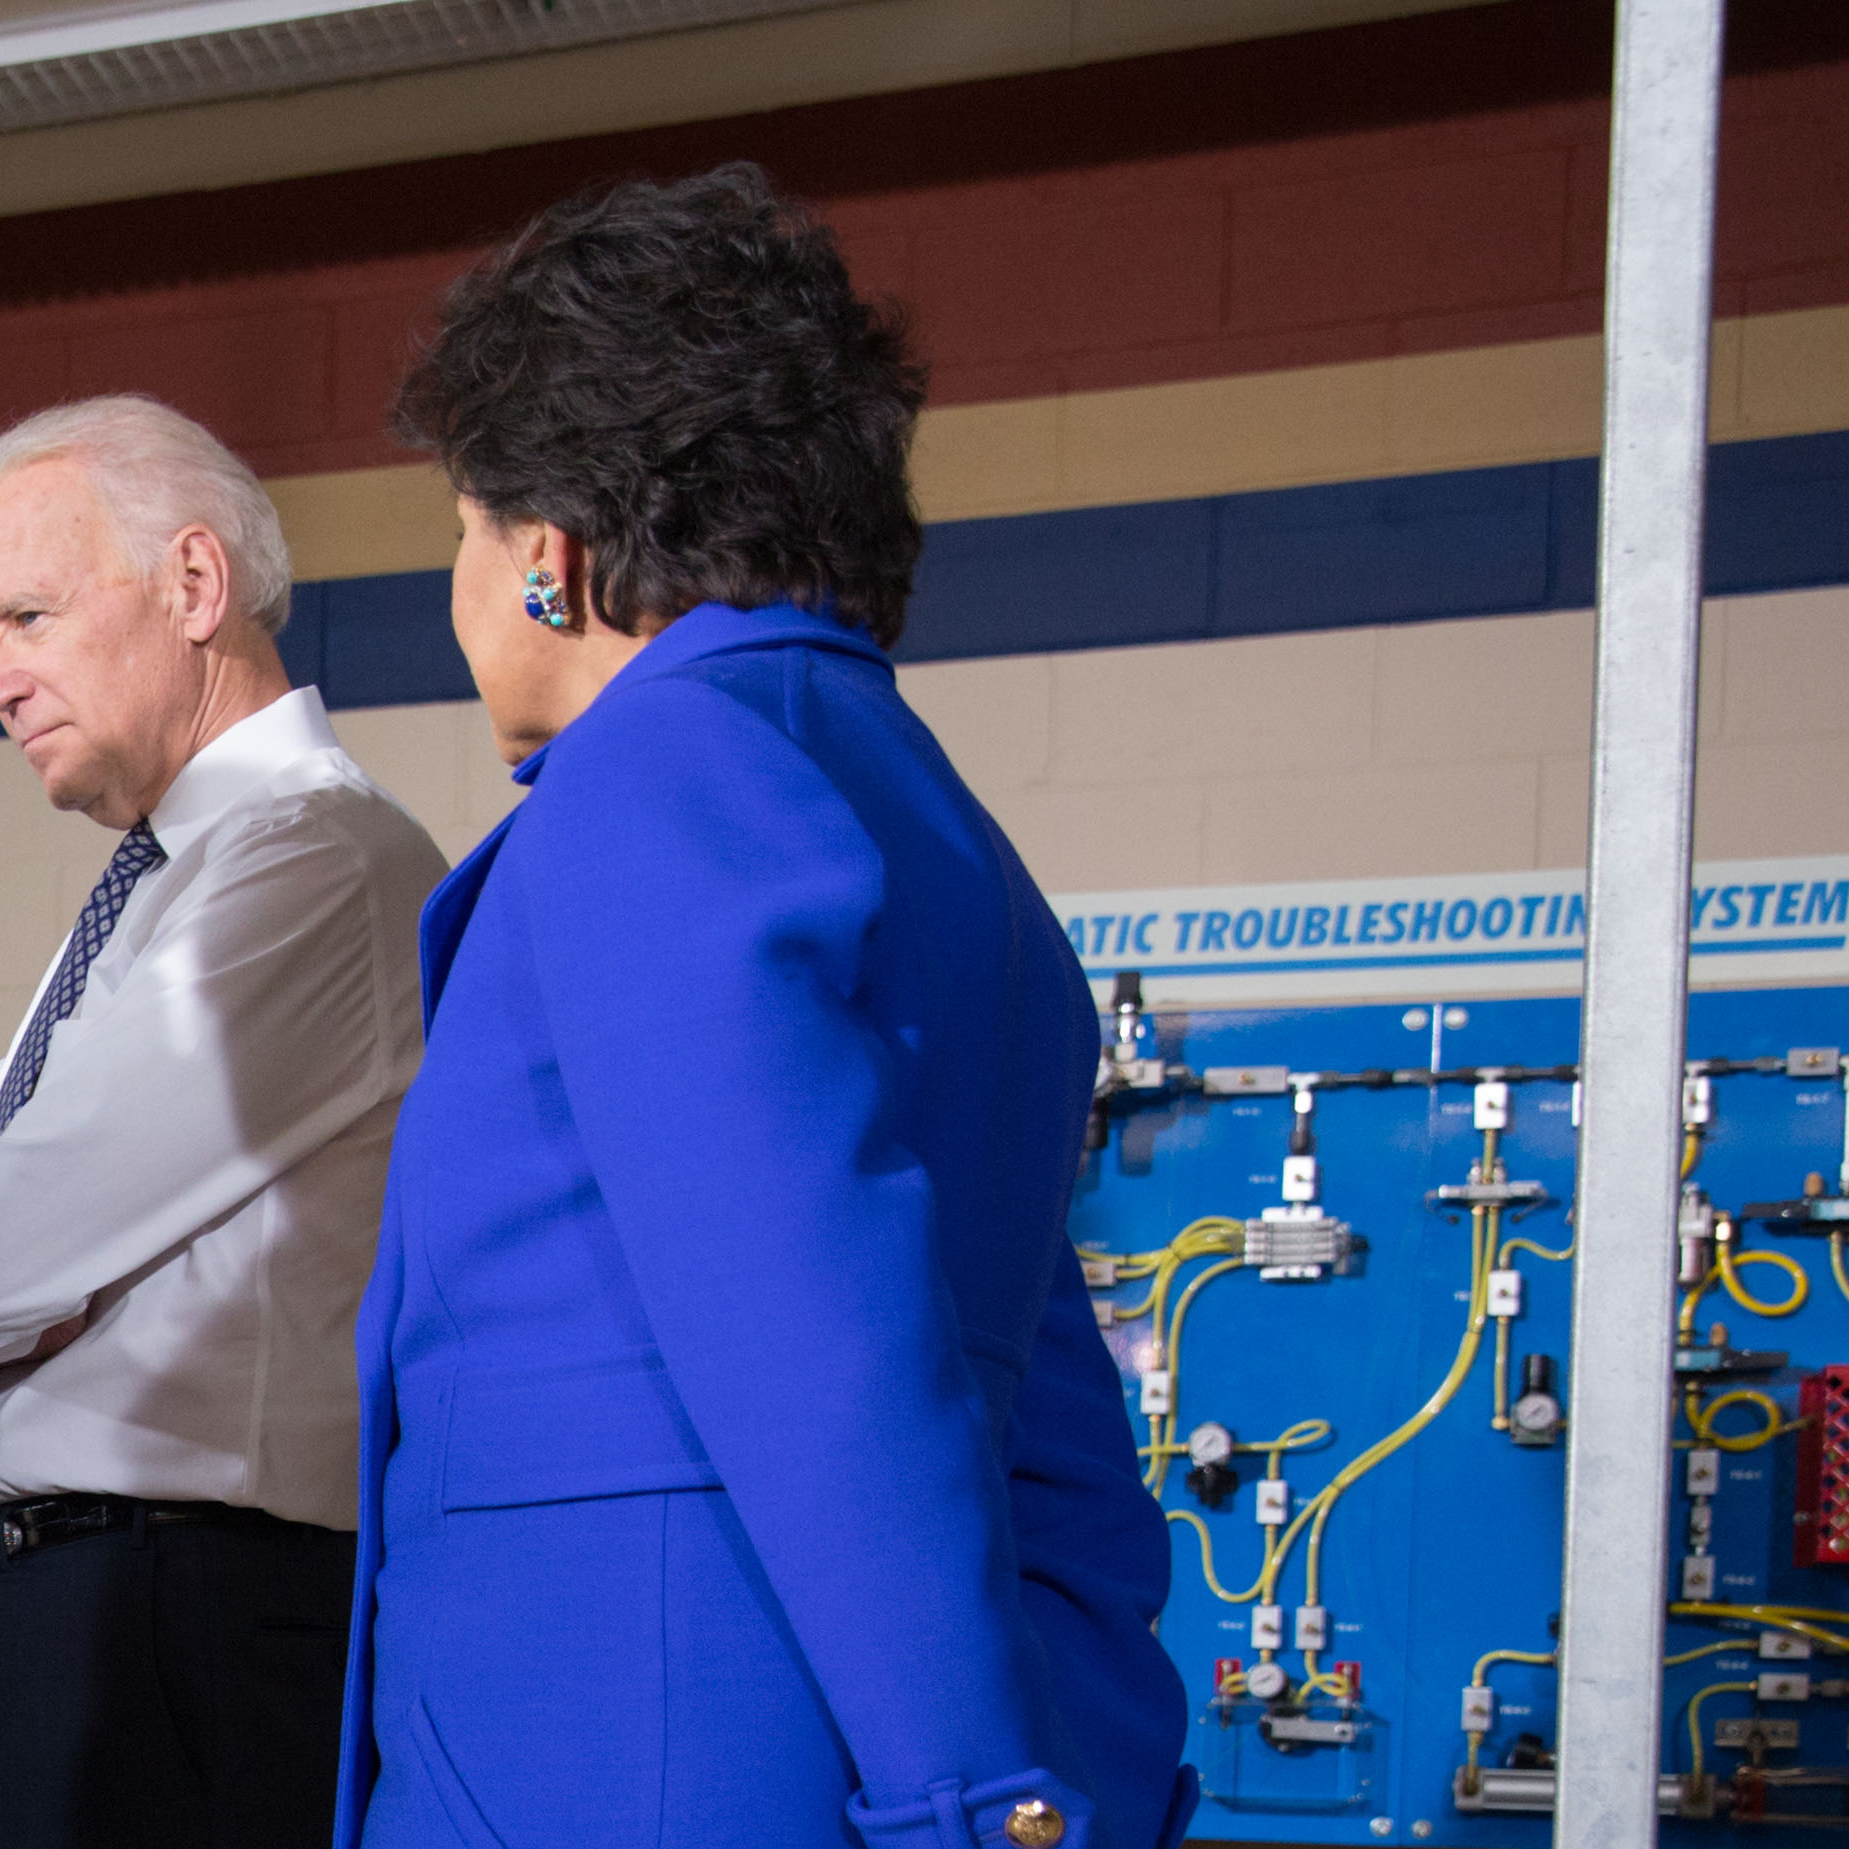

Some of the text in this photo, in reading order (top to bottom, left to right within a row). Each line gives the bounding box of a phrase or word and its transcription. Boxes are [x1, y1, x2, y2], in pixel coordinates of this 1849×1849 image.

[1065, 880, 1849, 956] ATIC TROUBLESHOOTIN YSTEM
